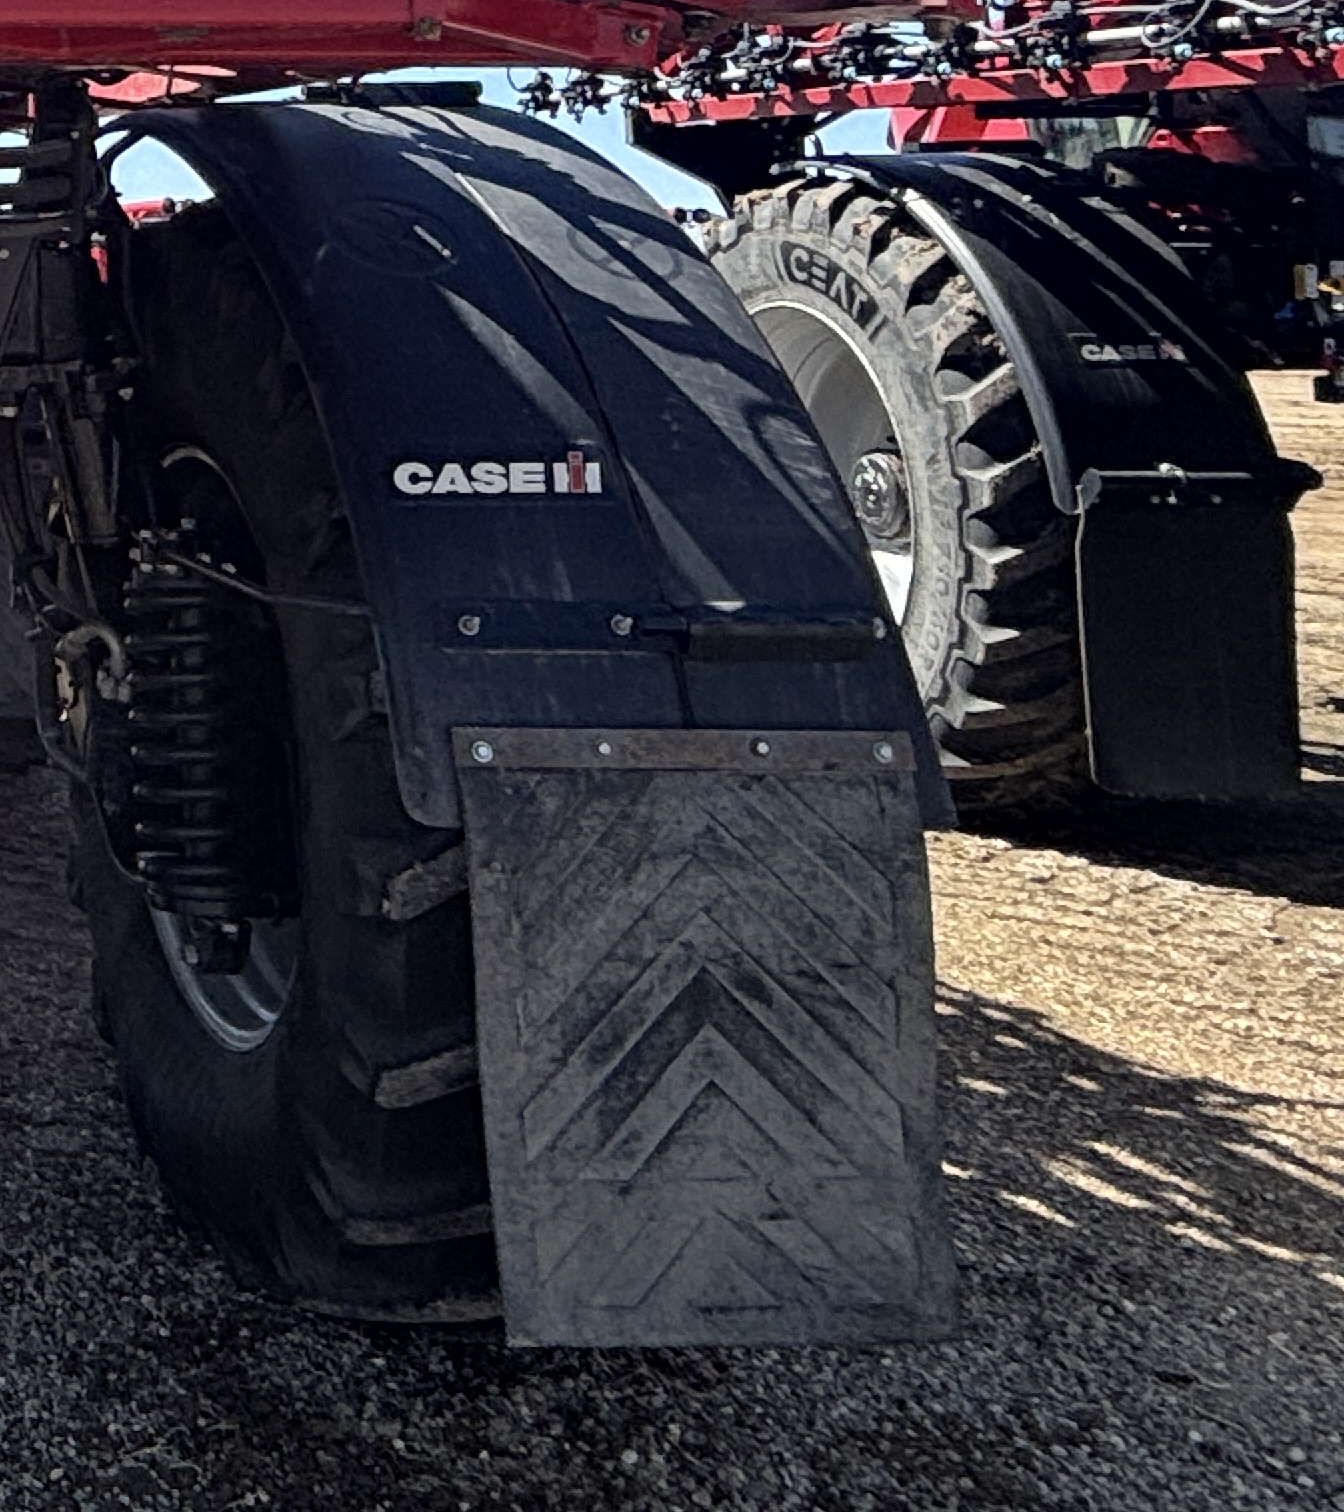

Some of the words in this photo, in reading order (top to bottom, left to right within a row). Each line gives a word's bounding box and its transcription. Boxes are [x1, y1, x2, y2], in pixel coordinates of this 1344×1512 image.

[790, 248, 869, 320] CEAT
[1080, 344, 1157, 361] CASE
[393, 462, 547, 495] CASE
